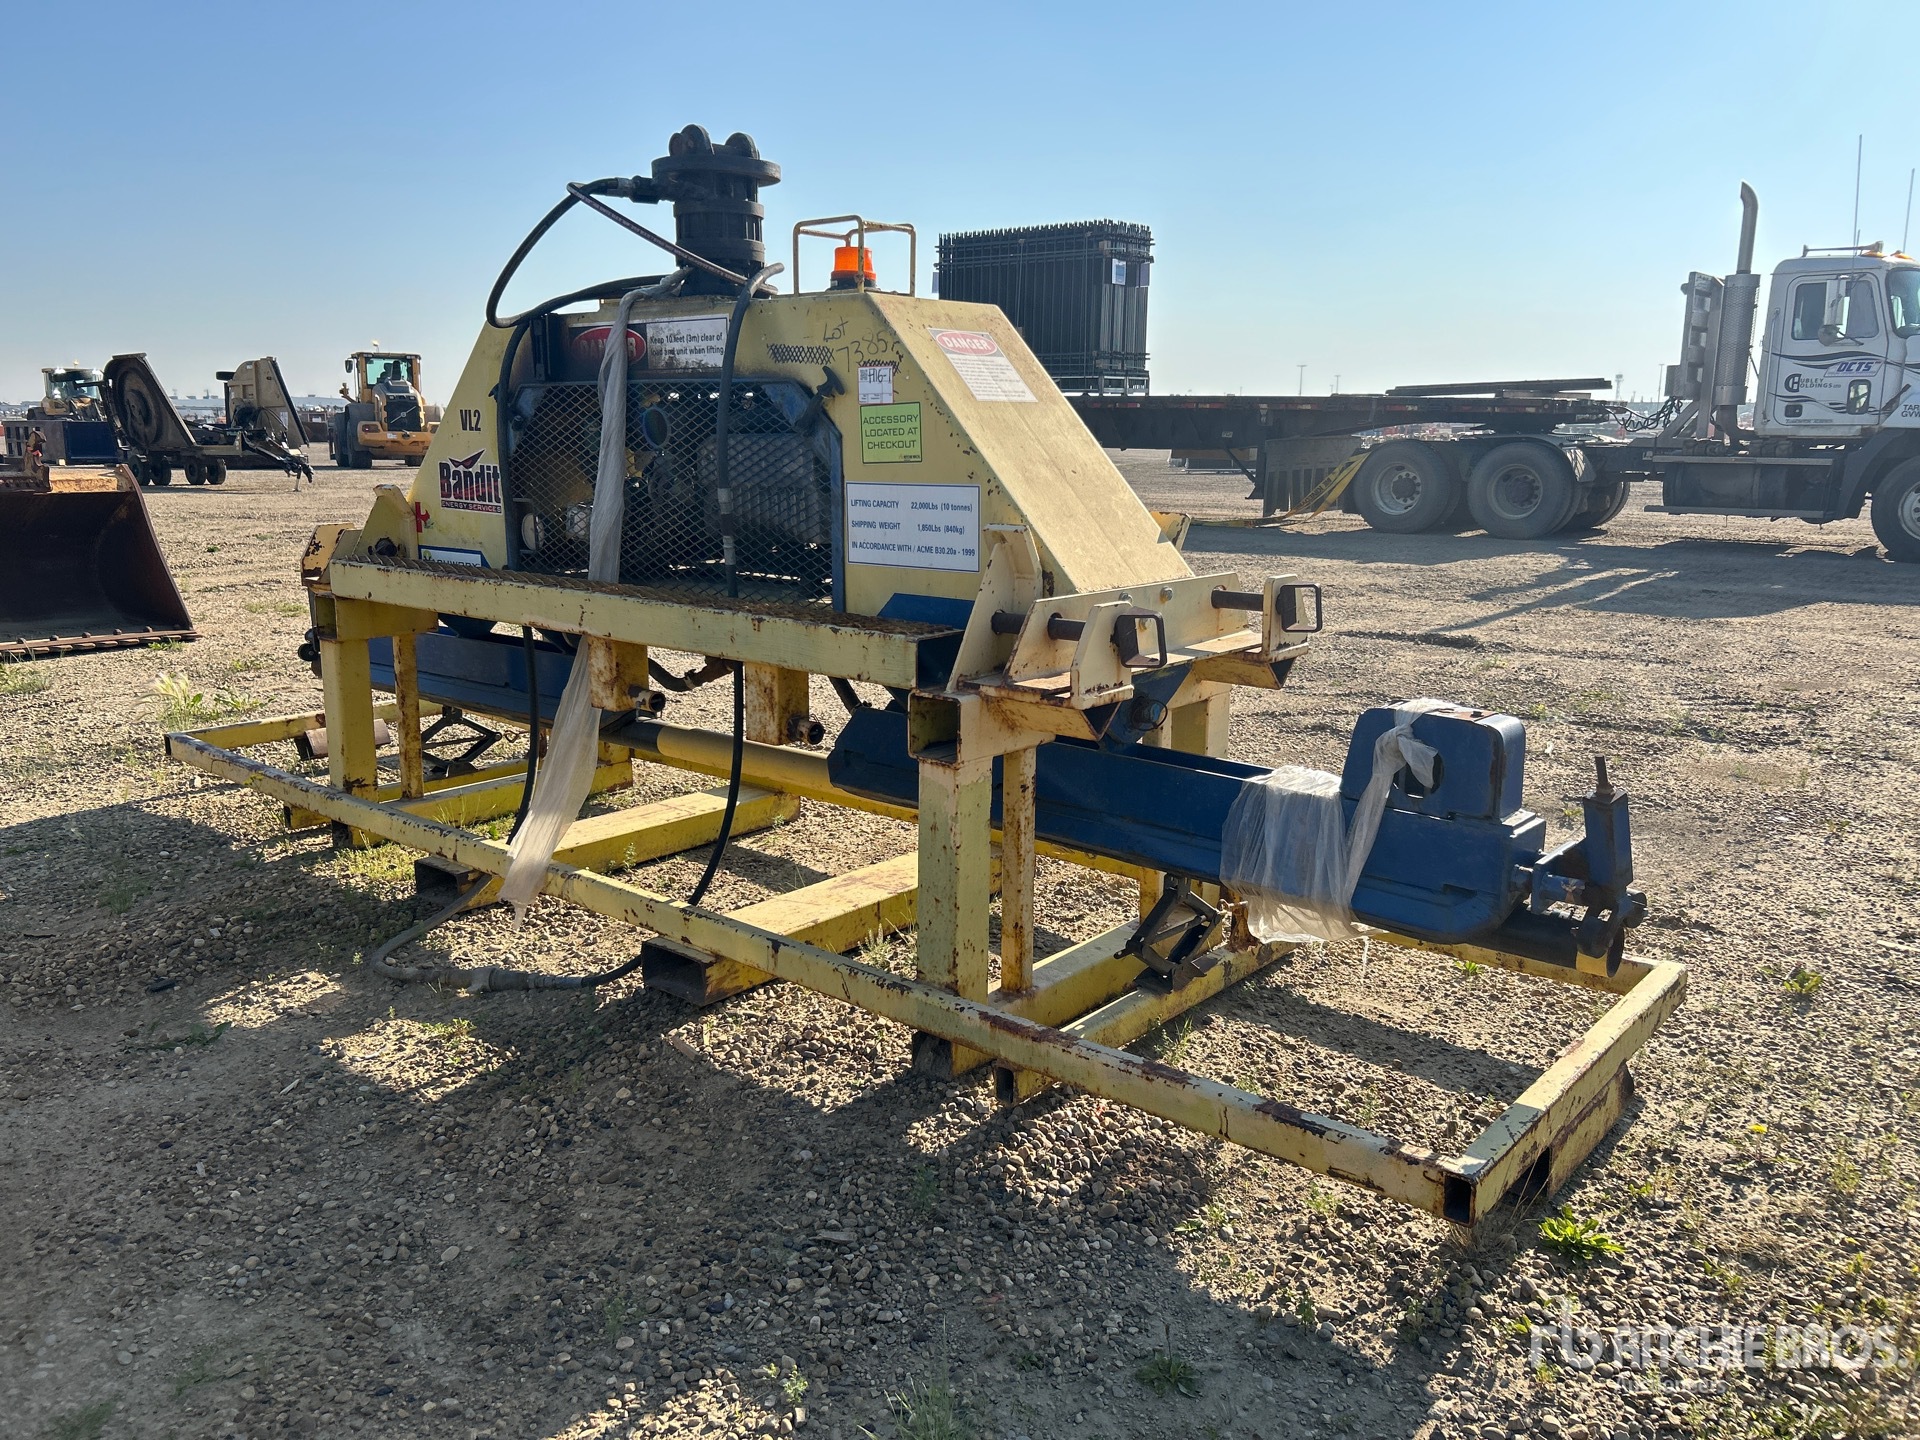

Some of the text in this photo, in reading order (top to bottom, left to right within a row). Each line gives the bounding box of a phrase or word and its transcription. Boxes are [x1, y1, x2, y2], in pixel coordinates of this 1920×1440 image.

[700, 333, 716, 342] clear
[717, 332, 723, 341] of
[942, 337, 992, 350] DANGER
[676, 346, 688, 355] unit
[459, 409, 481, 431] VL2
[863, 415, 919, 425] ACCESSORY
[864, 427, 918, 437] LOCATED AT
[867, 440, 917, 449] CHECKOUT
[439, 462, 502, 503] Bandit
[468, 504, 501, 512] SERVICES
[872, 500, 900, 509] CAPACITY
[911, 502, 938, 510] 22,000Lbs
[941, 502, 949, 511] (10
[950, 503, 973, 512] tonnes)
[851, 520, 965, 535] SHIPPING WEIGHT 1,850Lbs (840kg)
[852, 541, 858, 549] IN
[859, 542, 896, 552] ACCORDANCE
[897, 544, 912, 552] WITH
[962, 548, 976, 556] 1999
